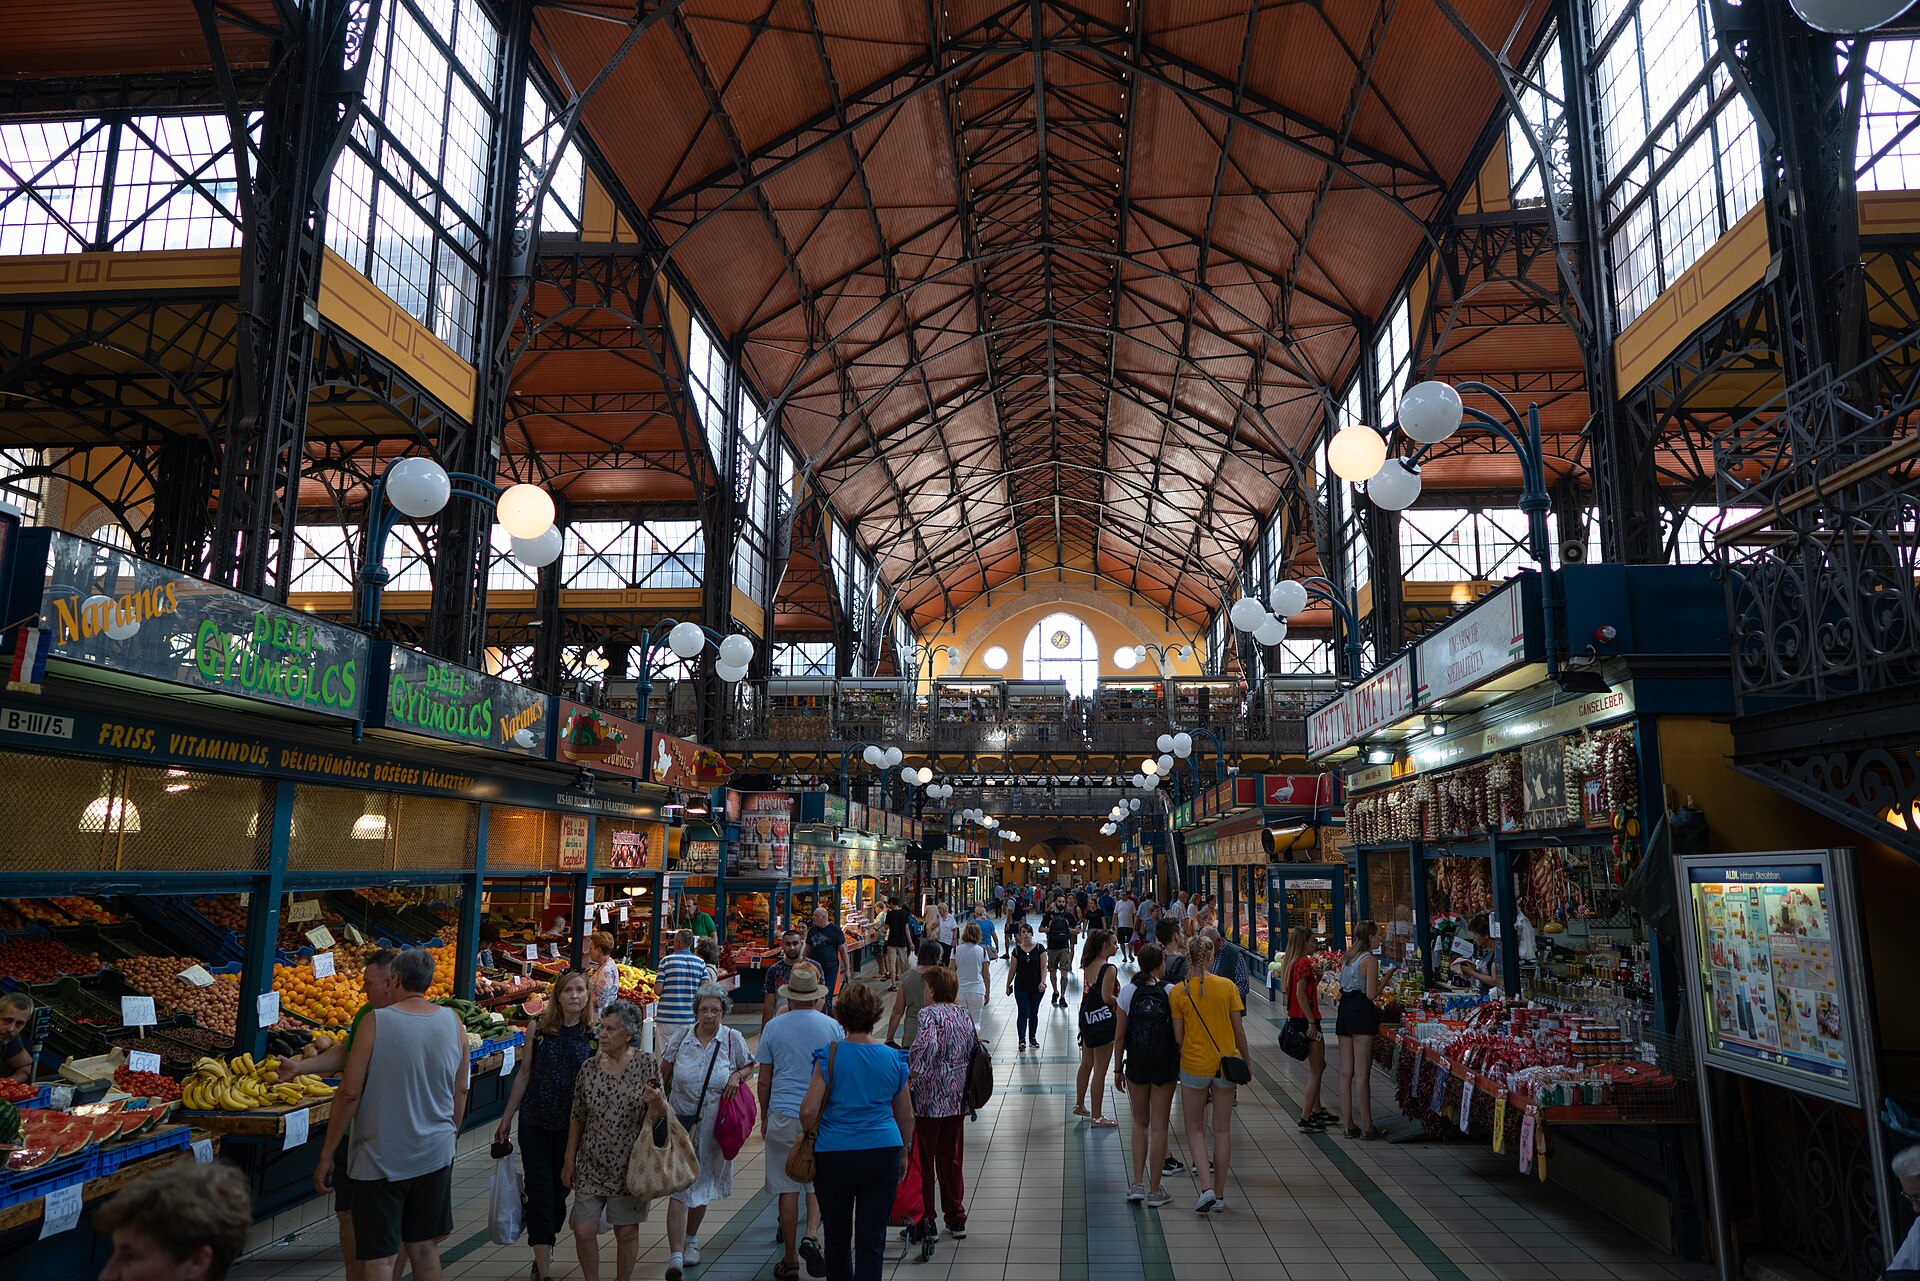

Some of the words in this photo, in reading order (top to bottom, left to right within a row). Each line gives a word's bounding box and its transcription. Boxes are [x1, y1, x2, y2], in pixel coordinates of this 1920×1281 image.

[53, 582, 177, 646] Narancs
[253, 613, 324, 655] DÉLI-
[196, 619, 356, 709] GYÜMÖLCS
[426, 664, 470, 699] DÉLI-
[8, 712, 66, 736] B-III/5.
[392, 674, 492, 740] GYÜMÖLCS
[500, 699, 543, 745] Narancs
[1313, 701, 1347, 752] KMETTY
[1355, 664, 1402, 733] KMETTY
[1579, 692, 1624, 717] GÄNSELEBER
[99, 722, 156, 754] FRISS,
[280, 746, 371, 779] DÉLIGYÜMÖLCS
[374, 761, 419, 785] BŐSÉGES
[1085, 1005, 1112, 1024] VANS
